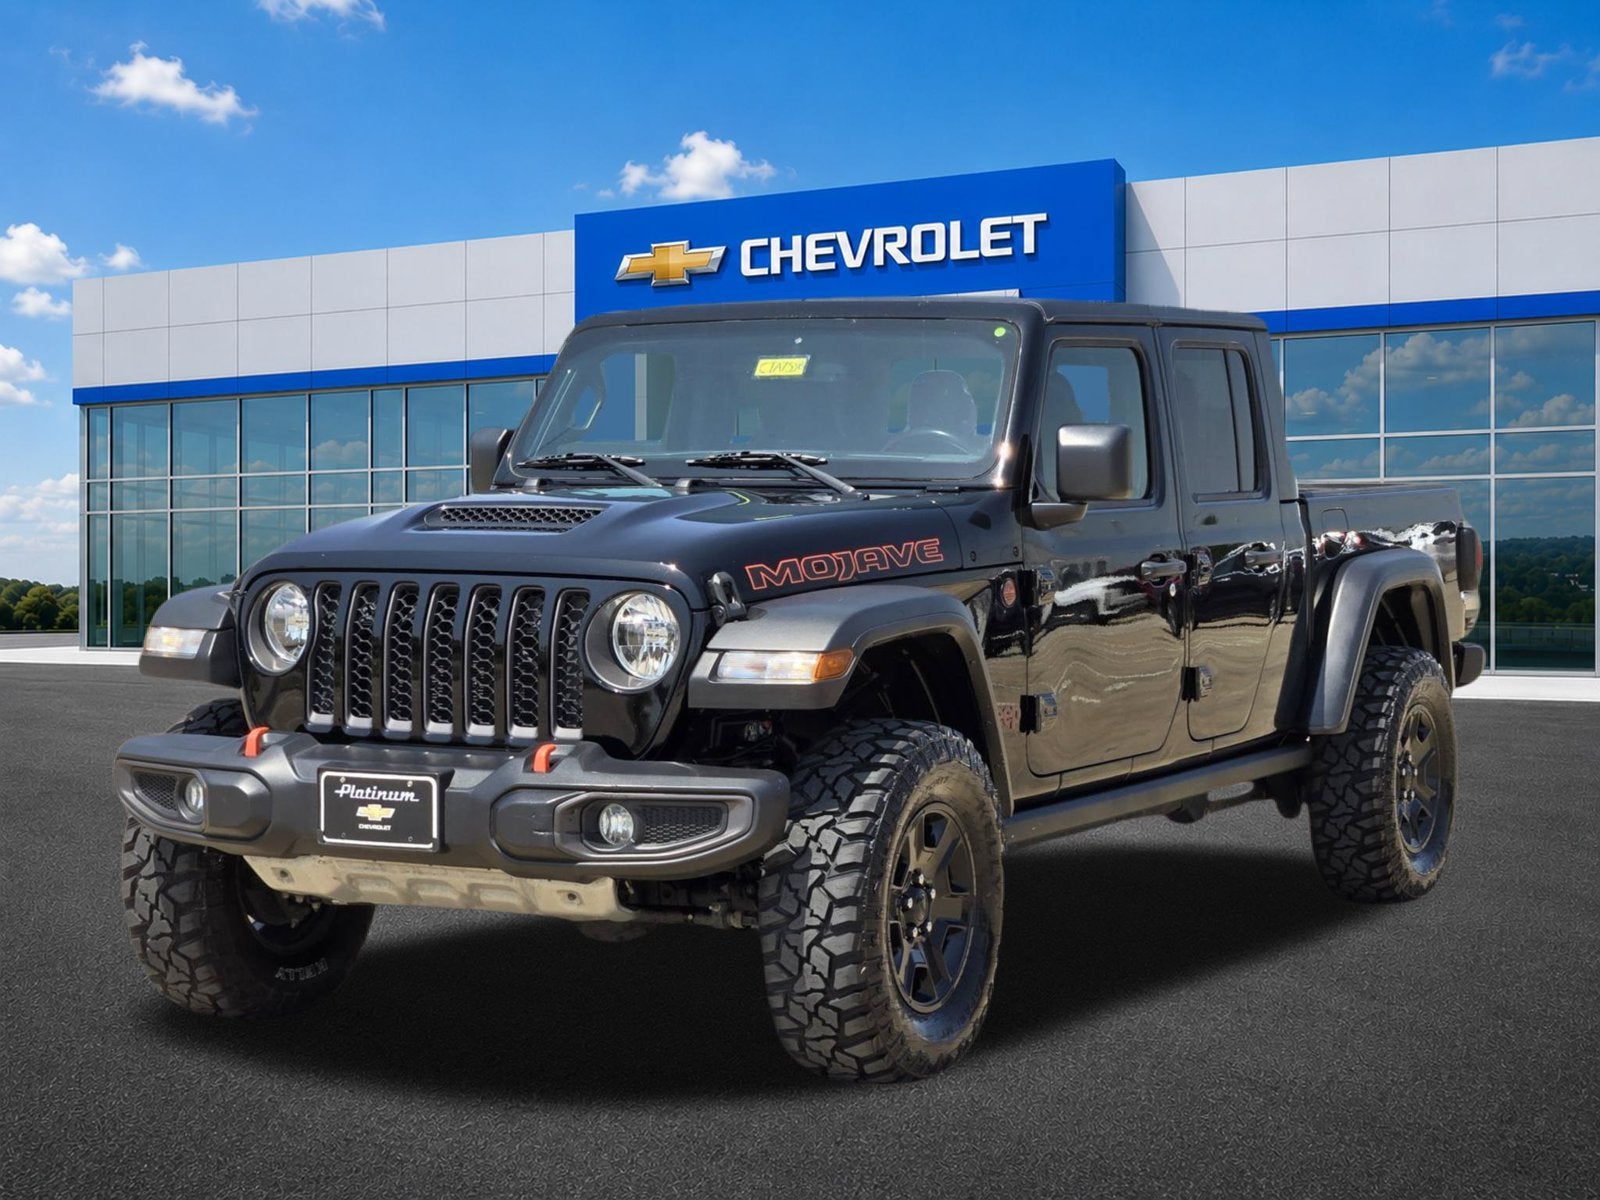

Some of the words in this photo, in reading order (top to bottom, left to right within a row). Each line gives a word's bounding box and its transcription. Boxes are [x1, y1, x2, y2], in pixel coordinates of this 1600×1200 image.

[740, 212, 1048, 277] CHEVROLET
[745, 538, 944, 590] MOJAVE
[334, 783, 420, 802] Platinum
[358, 823, 392, 831] CHEVROLET
